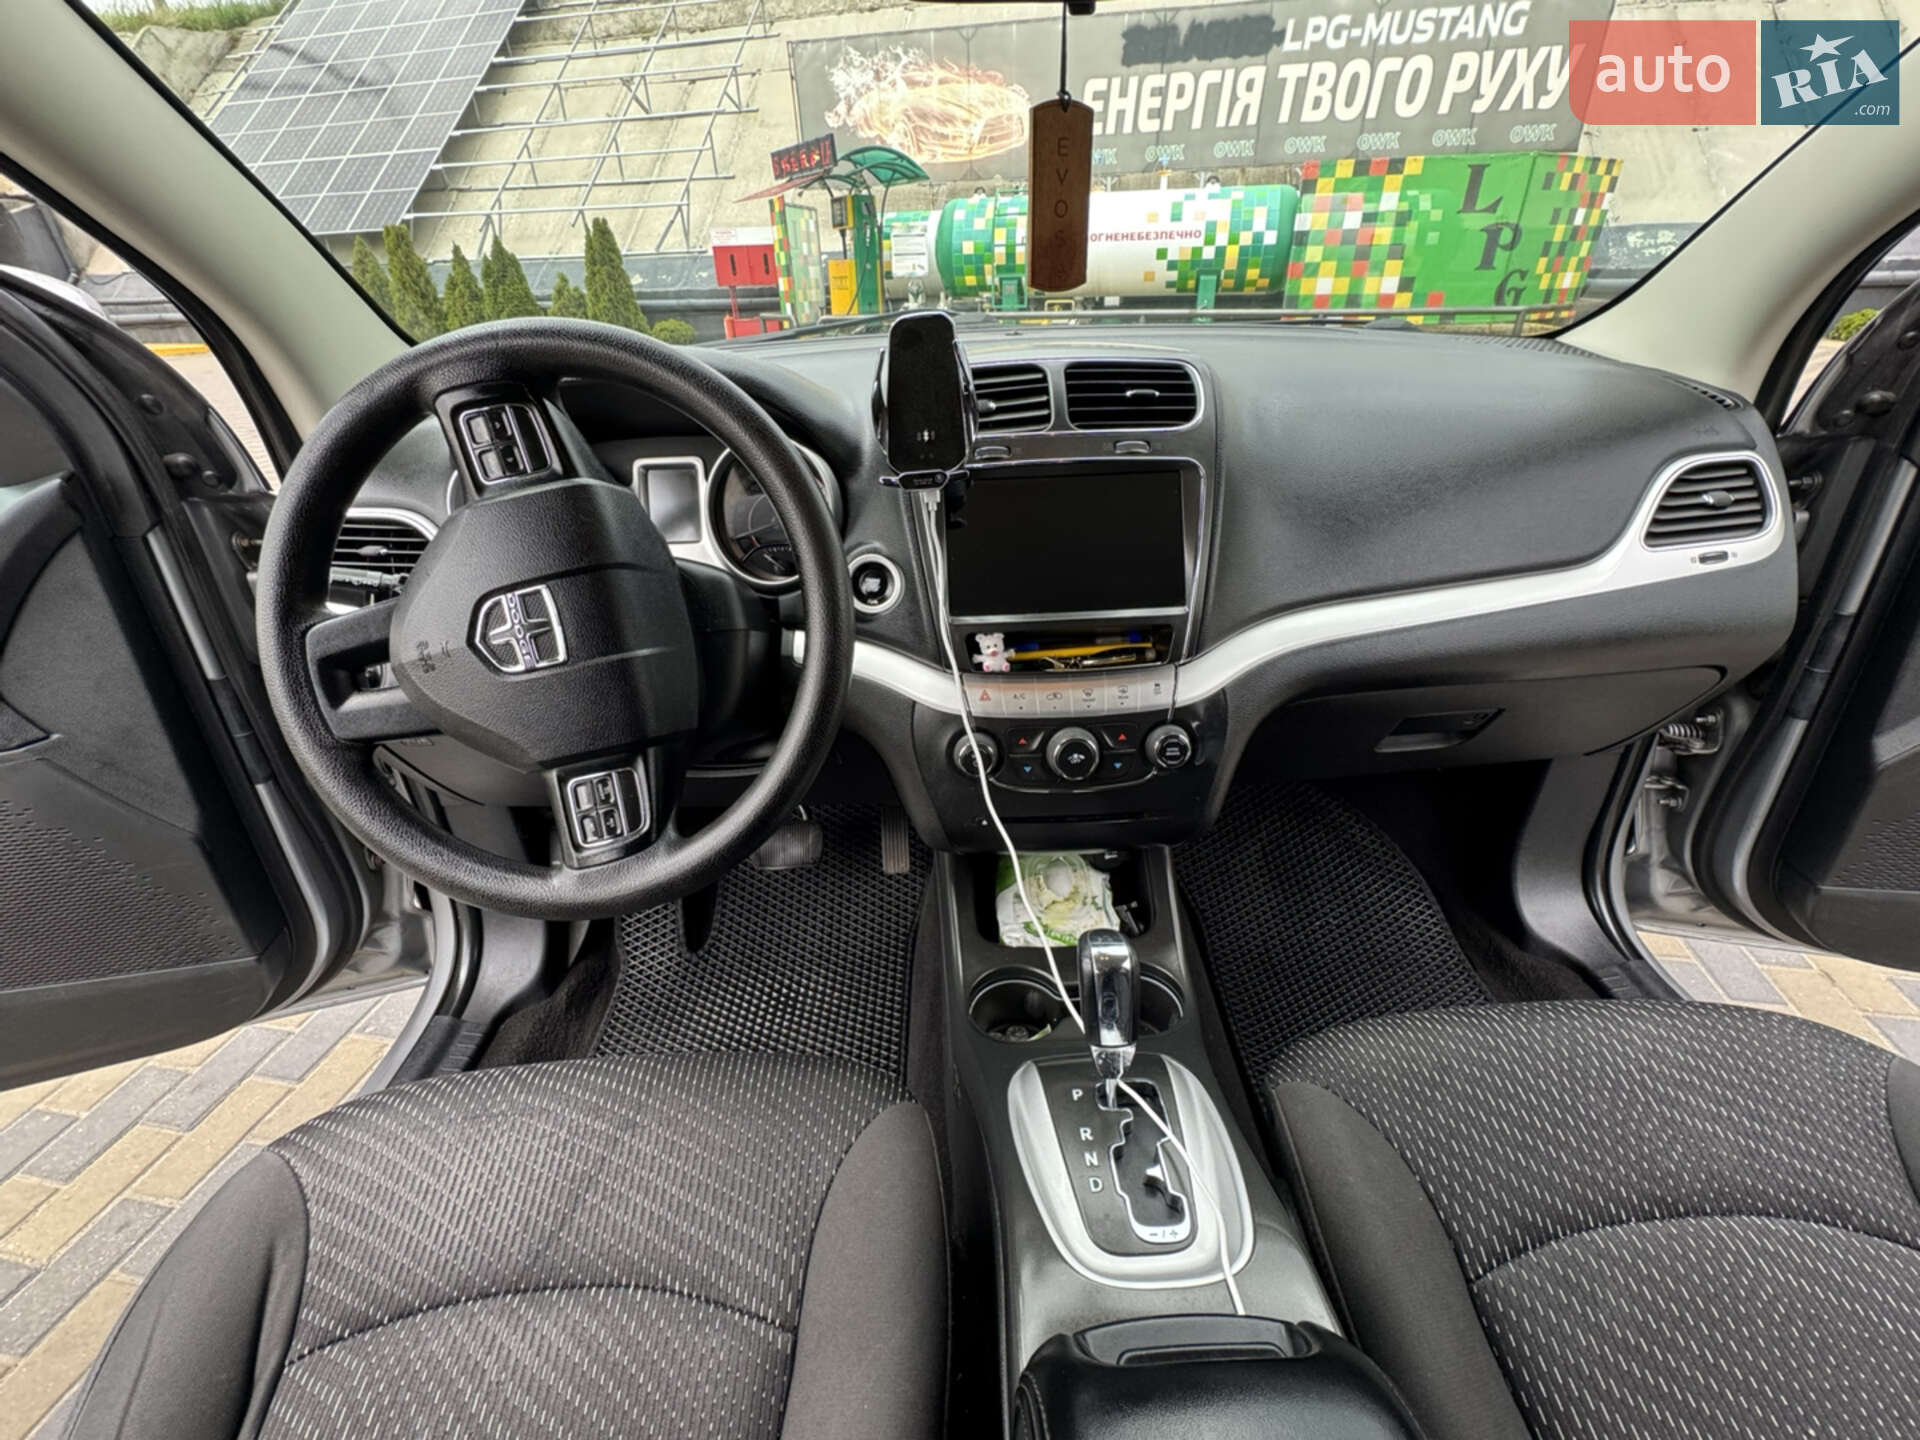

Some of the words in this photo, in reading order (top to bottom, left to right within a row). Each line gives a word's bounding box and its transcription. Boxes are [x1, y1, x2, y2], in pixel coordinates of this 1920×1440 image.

[1282, 1, 1531, 50] LPG-MUSTANG
[1277, 54, 1434, 123] ТВОГО
[1089, 230, 1202, 242] ОГНЕНЕБЕЗПЕЧНО
[1072, 1089, 1083, 1101] P
[1080, 1127, 1093, 1141] R
[1085, 1152, 1098, 1166] N
[1089, 1177, 1103, 1192] D
